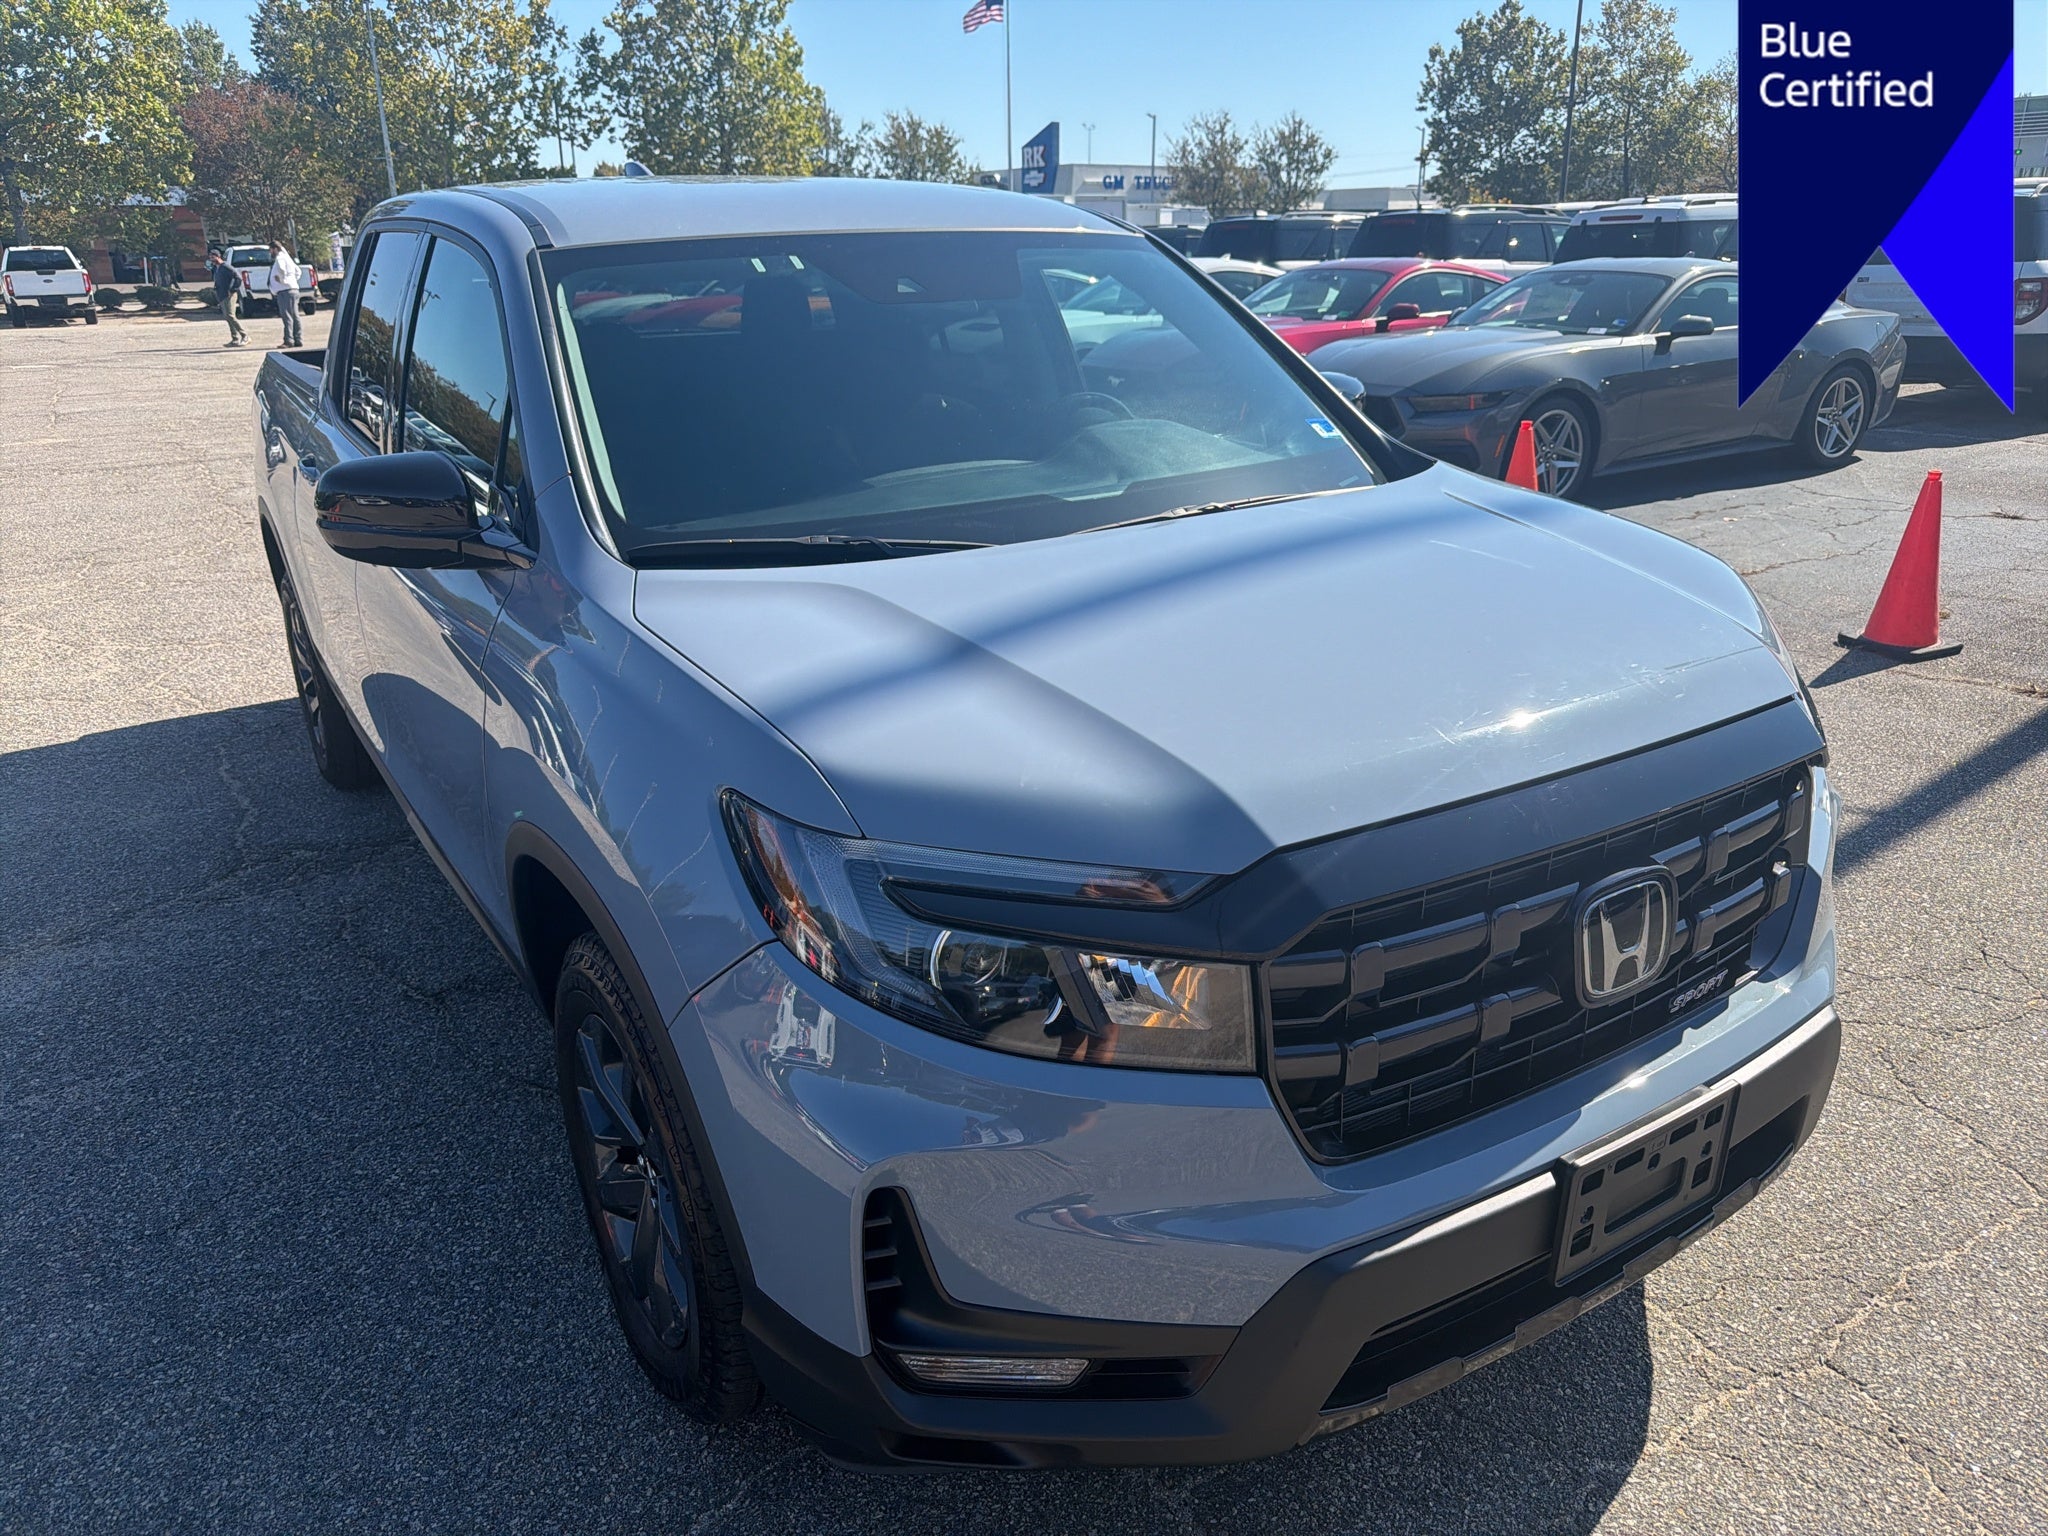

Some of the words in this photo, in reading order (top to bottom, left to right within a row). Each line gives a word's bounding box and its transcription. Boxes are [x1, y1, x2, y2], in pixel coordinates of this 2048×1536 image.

[1023, 145, 1046, 169] RK
[1103, 175, 1124, 190] GM
[1669, 968, 1729, 1014] SPORT
